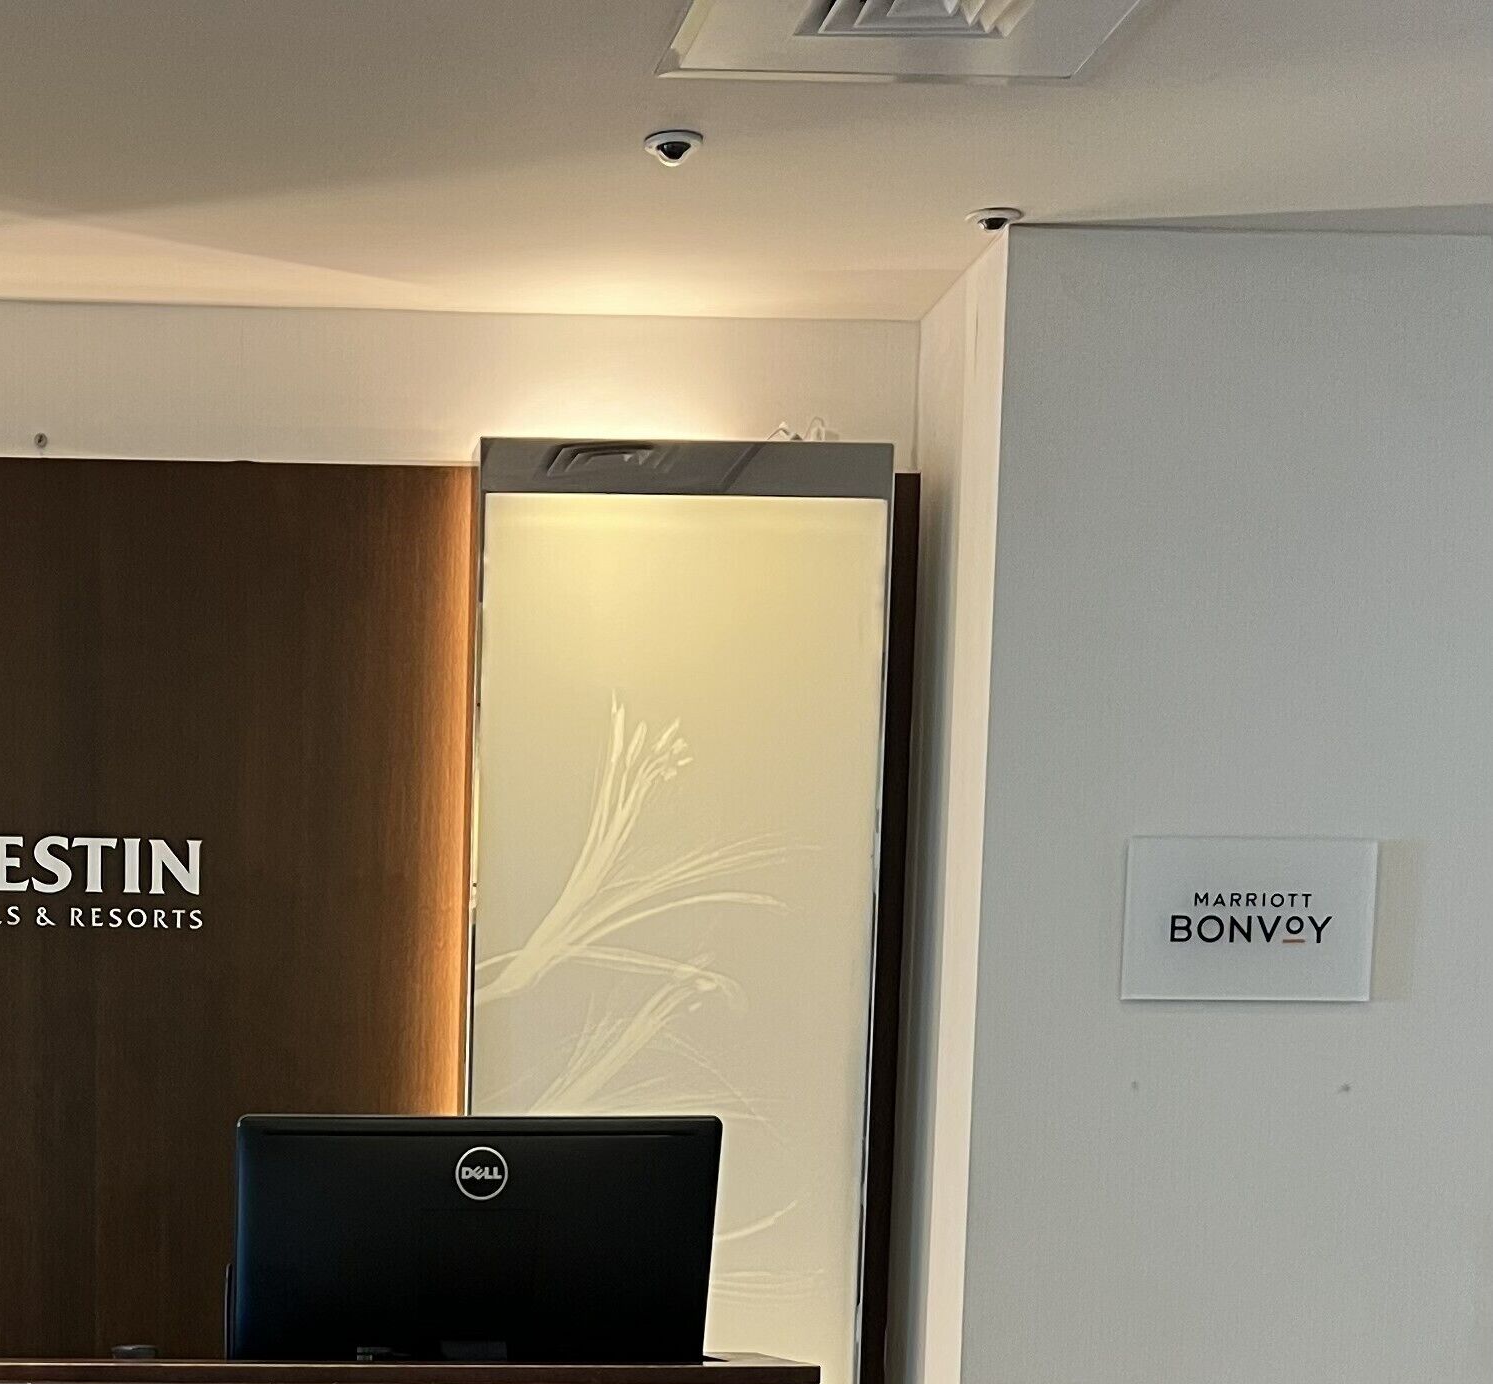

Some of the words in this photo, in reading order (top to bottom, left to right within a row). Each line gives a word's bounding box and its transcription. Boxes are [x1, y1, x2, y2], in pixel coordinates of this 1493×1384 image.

[1194, 892, 1313, 908] MARRIOTT
[35, 906, 56, 927] &
[70, 907, 203, 930] RESORTS
[1169, 914, 1333, 943] BONVOY
[461, 1165, 503, 1180] DELL
